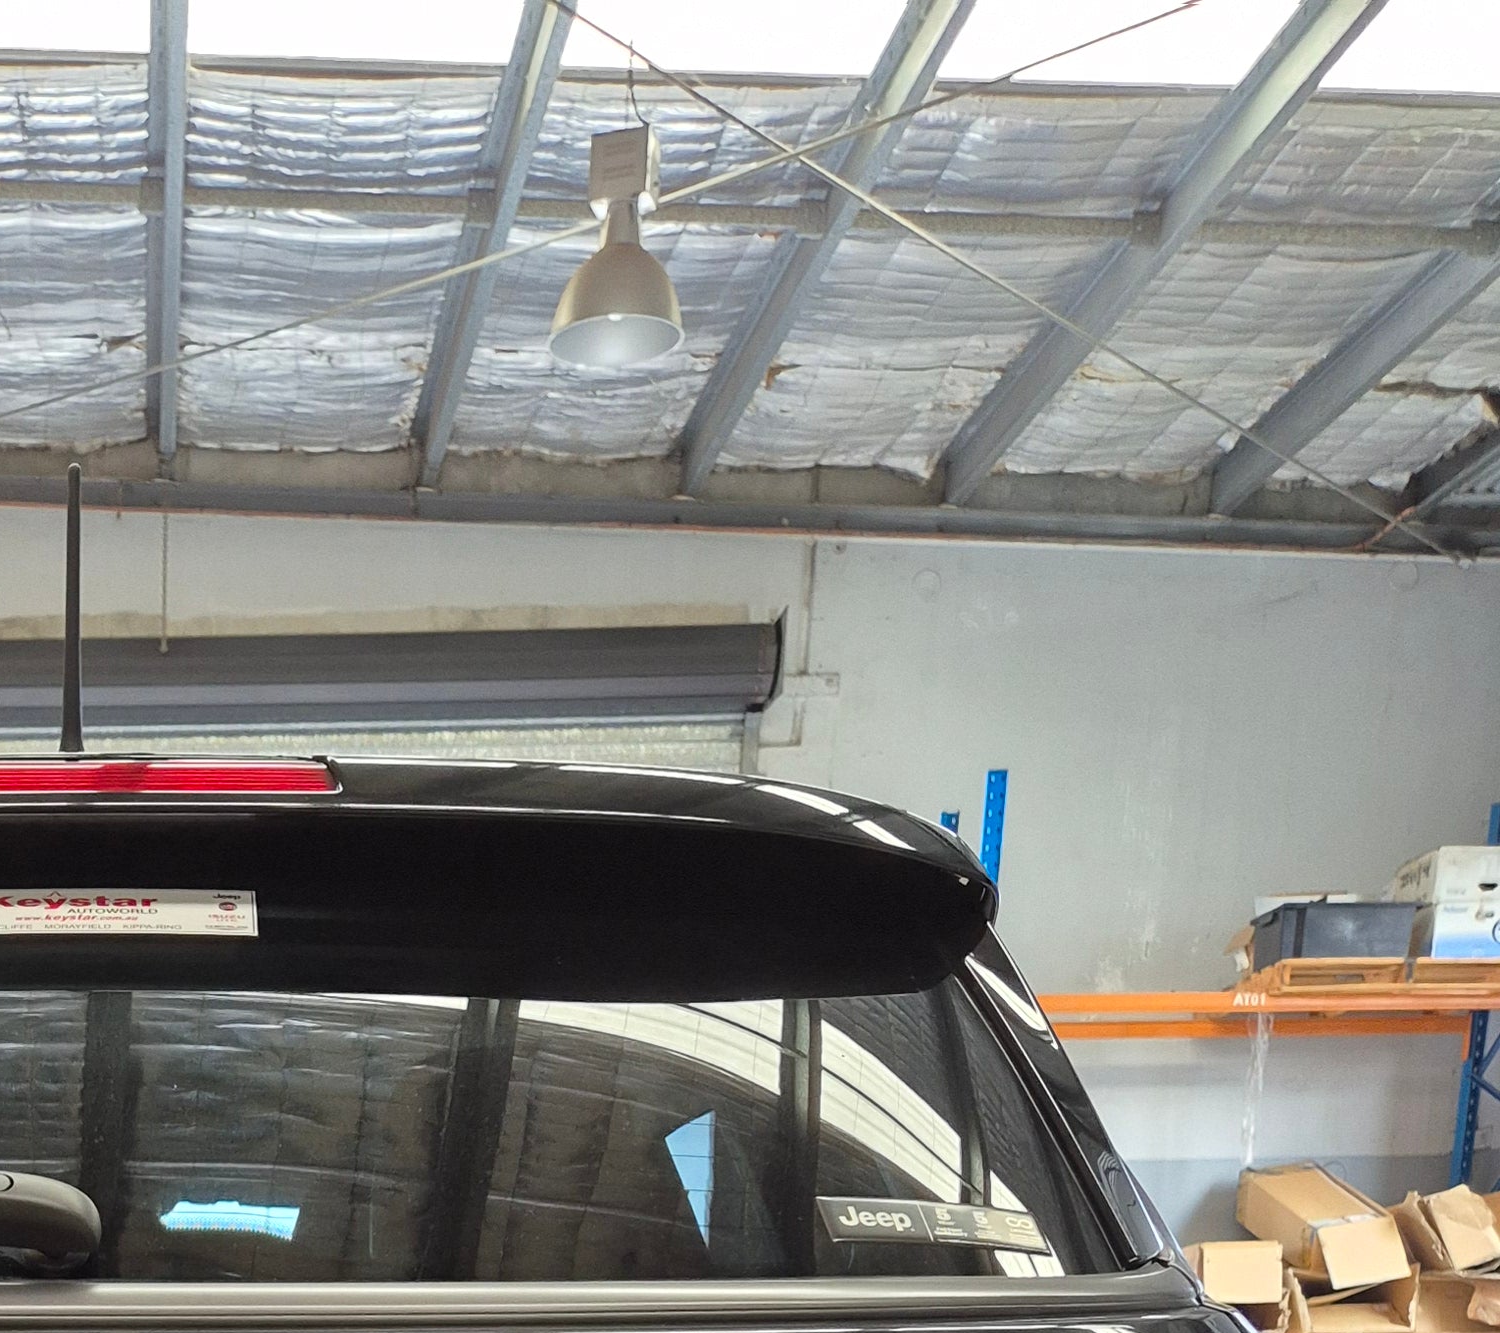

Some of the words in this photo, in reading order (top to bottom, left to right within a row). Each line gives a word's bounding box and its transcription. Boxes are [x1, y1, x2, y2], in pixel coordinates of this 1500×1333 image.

[15, 914, 139, 922] www.keystar.com.au
[1232, 992, 1267, 1007] AT01
[839, 1206, 912, 1231] Jeep
